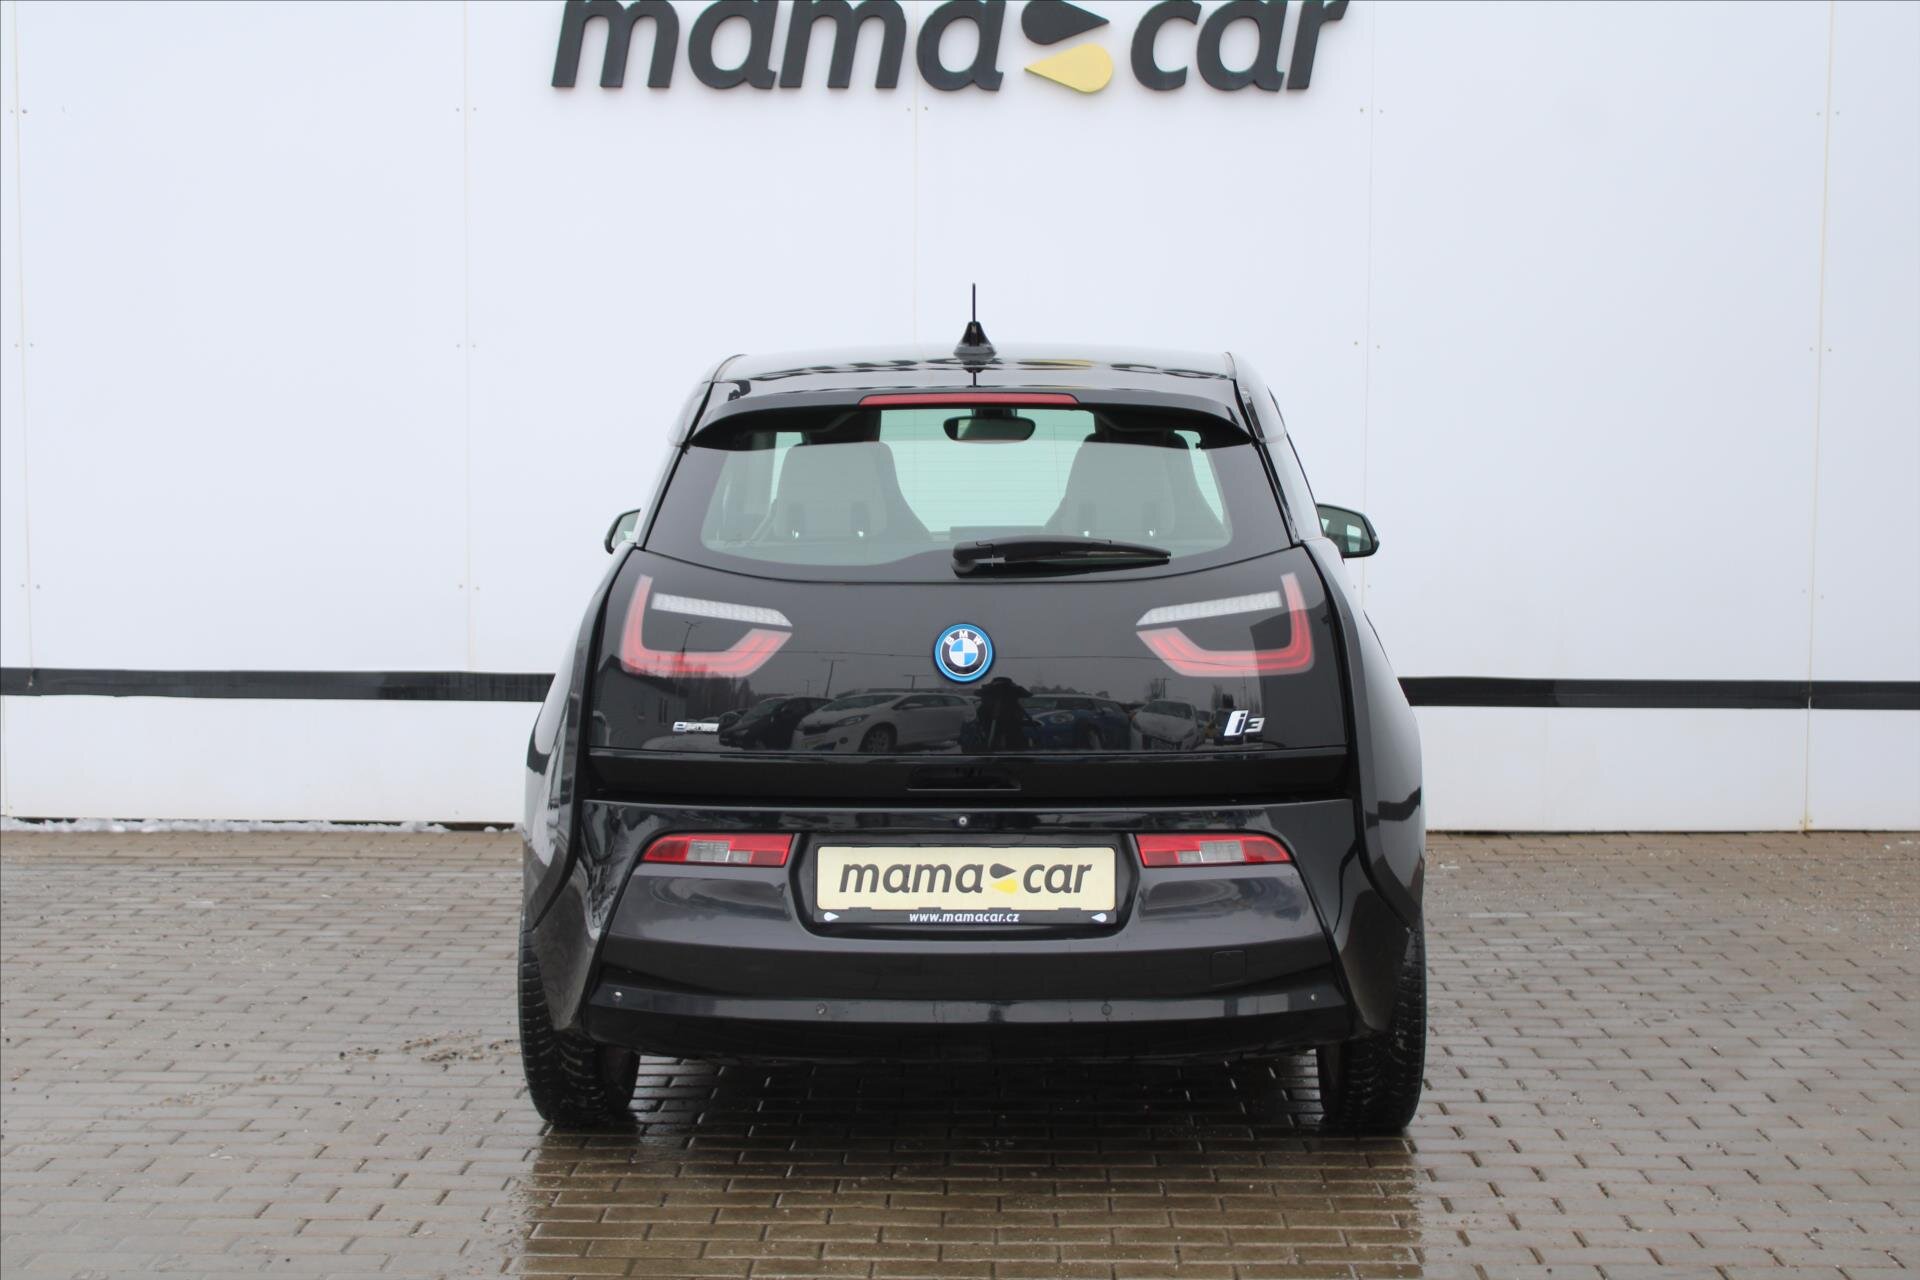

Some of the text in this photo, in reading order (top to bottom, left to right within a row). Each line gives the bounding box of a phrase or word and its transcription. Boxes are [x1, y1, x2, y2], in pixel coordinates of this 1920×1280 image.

[551, 0, 1349, 91] mama car
[945, 630, 983, 646] BMW
[1223, 709, 1265, 737] i3
[839, 863, 1092, 894] mama car
[909, 911, 1019, 923] www.mamacar.cz
